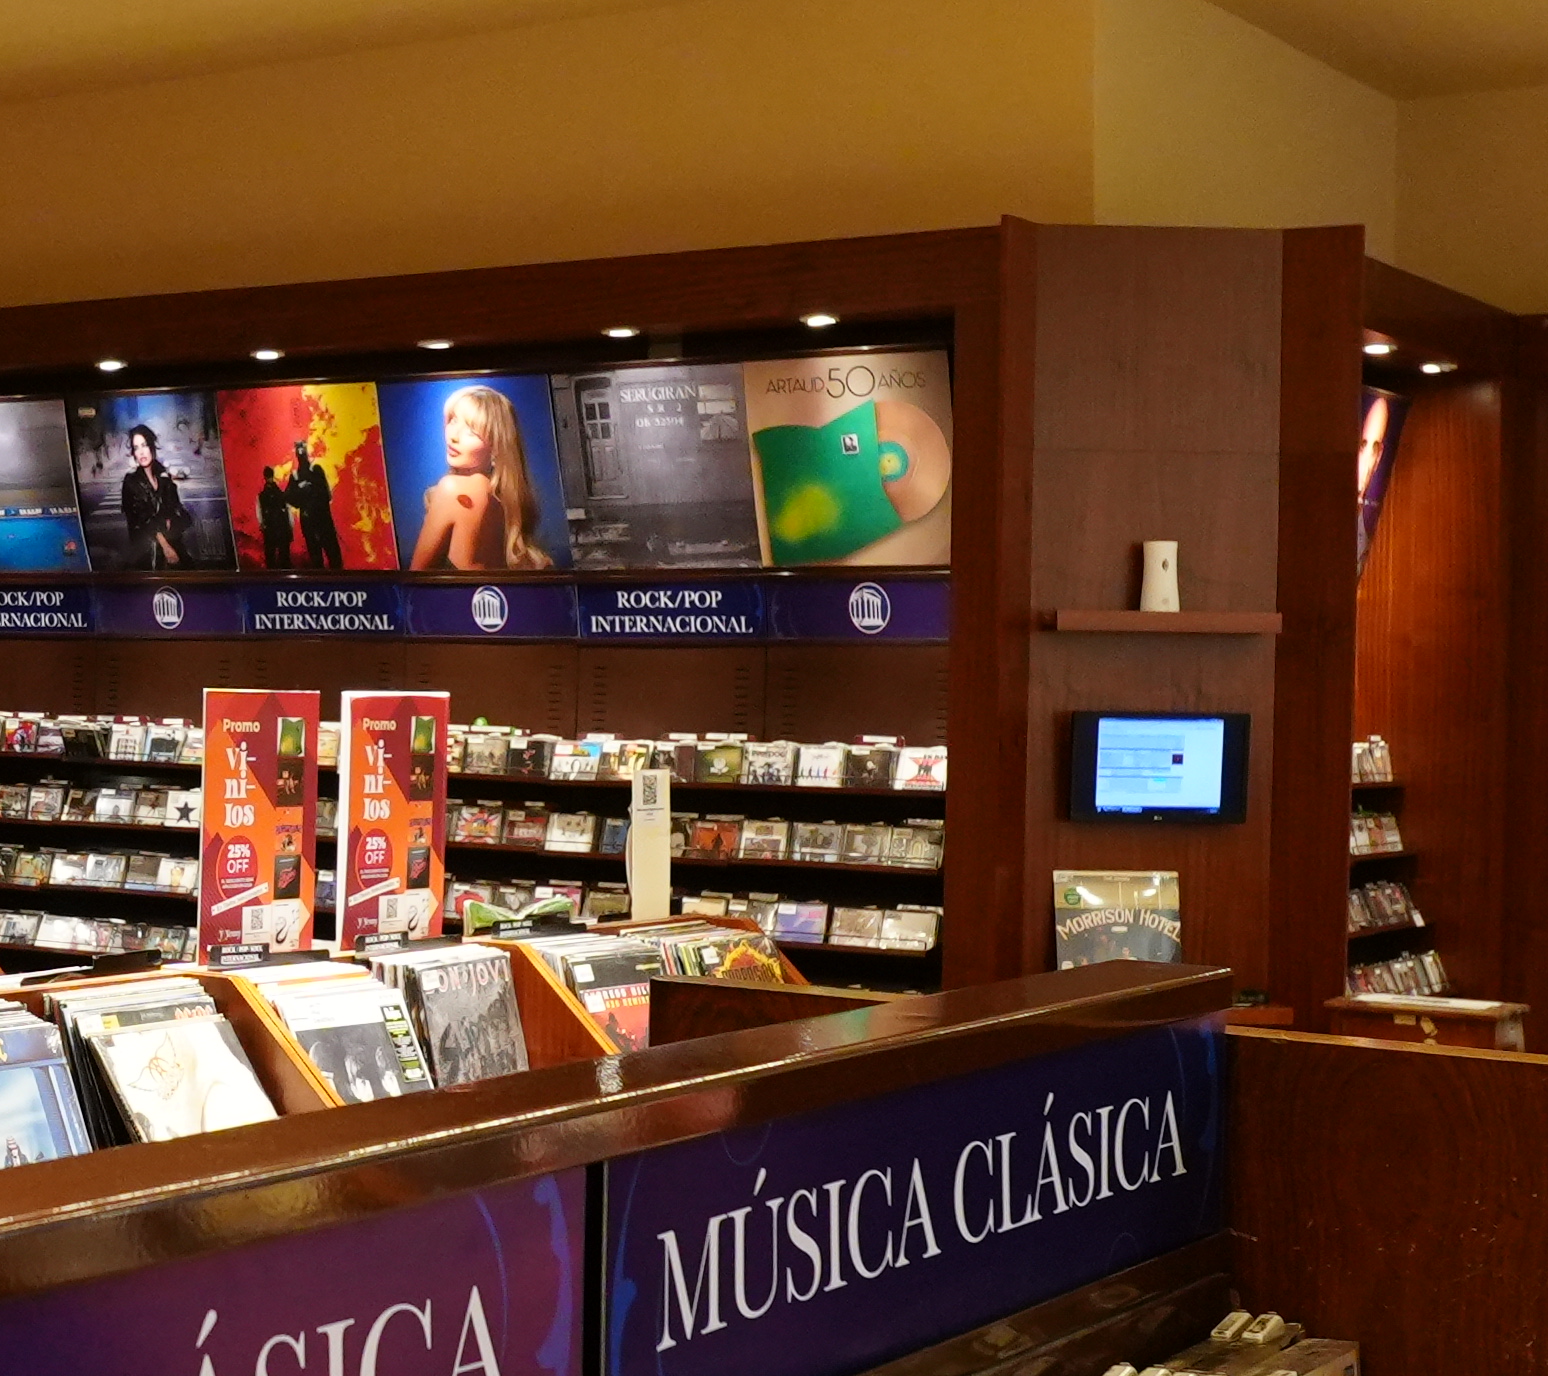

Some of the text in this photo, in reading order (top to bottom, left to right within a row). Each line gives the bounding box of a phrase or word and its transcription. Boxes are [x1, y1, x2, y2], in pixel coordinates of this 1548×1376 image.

[766, 366, 926, 398] ARTAUD 50 AÑOS
[276, 591, 367, 607] ROCK/POP
[617, 590, 722, 609] ROCK/POP
[254, 614, 394, 630] INTERNACIONAL
[591, 615, 753, 633] INTERNACIONAL
[222, 719, 261, 733] Promo
[363, 718, 396, 731] Promo
[227, 844, 251, 858] 25%
[366, 836, 386, 850] 25%
[365, 851, 385, 864] OFF
[227, 860, 249, 873] OFF
[1056, 909, 1181, 942] MORRISON HOTEL
[657, 1092, 1185, 1351] MÚSICA CLÁSICA
